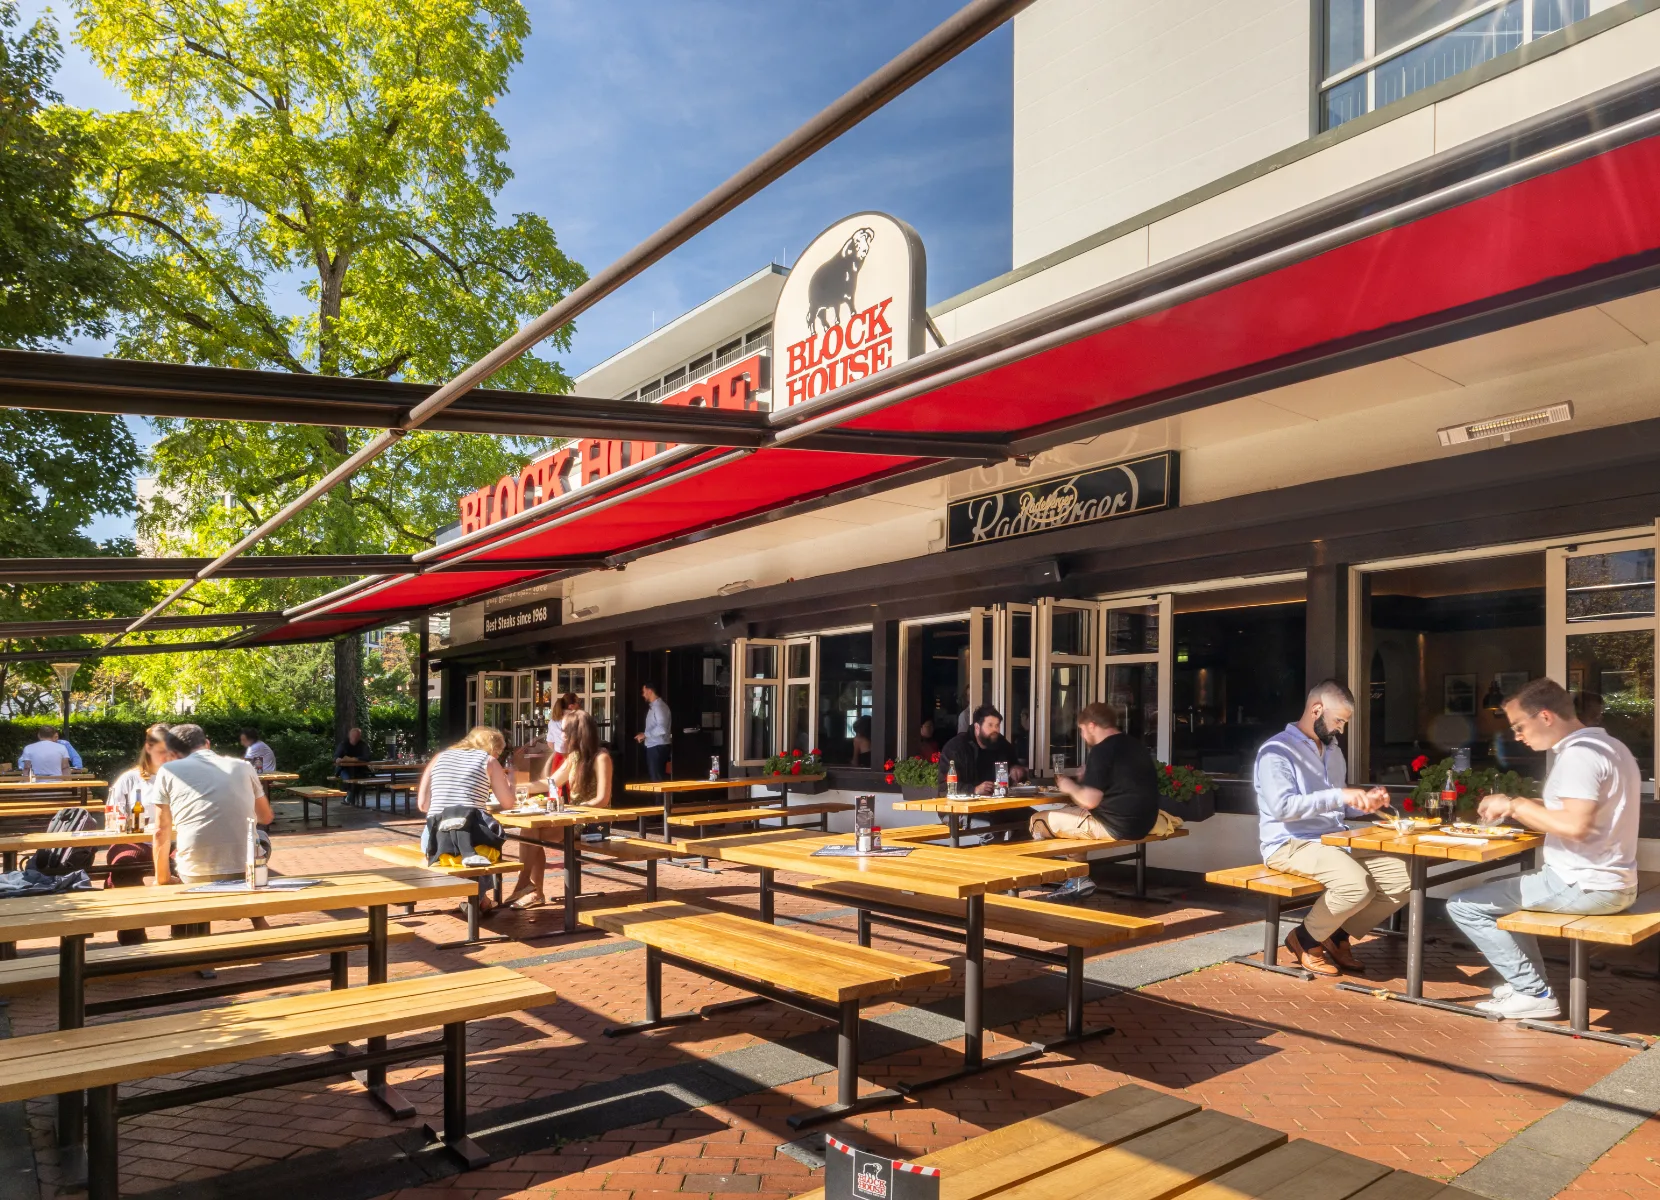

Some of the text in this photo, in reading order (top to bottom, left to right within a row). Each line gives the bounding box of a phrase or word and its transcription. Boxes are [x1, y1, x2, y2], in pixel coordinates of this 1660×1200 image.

[786, 297, 892, 379] BLOCK
[786, 336, 892, 407] HOUSE
[460, 448, 572, 536] BLOCK
[485, 606, 548, 632] Best Steaks since 1968
